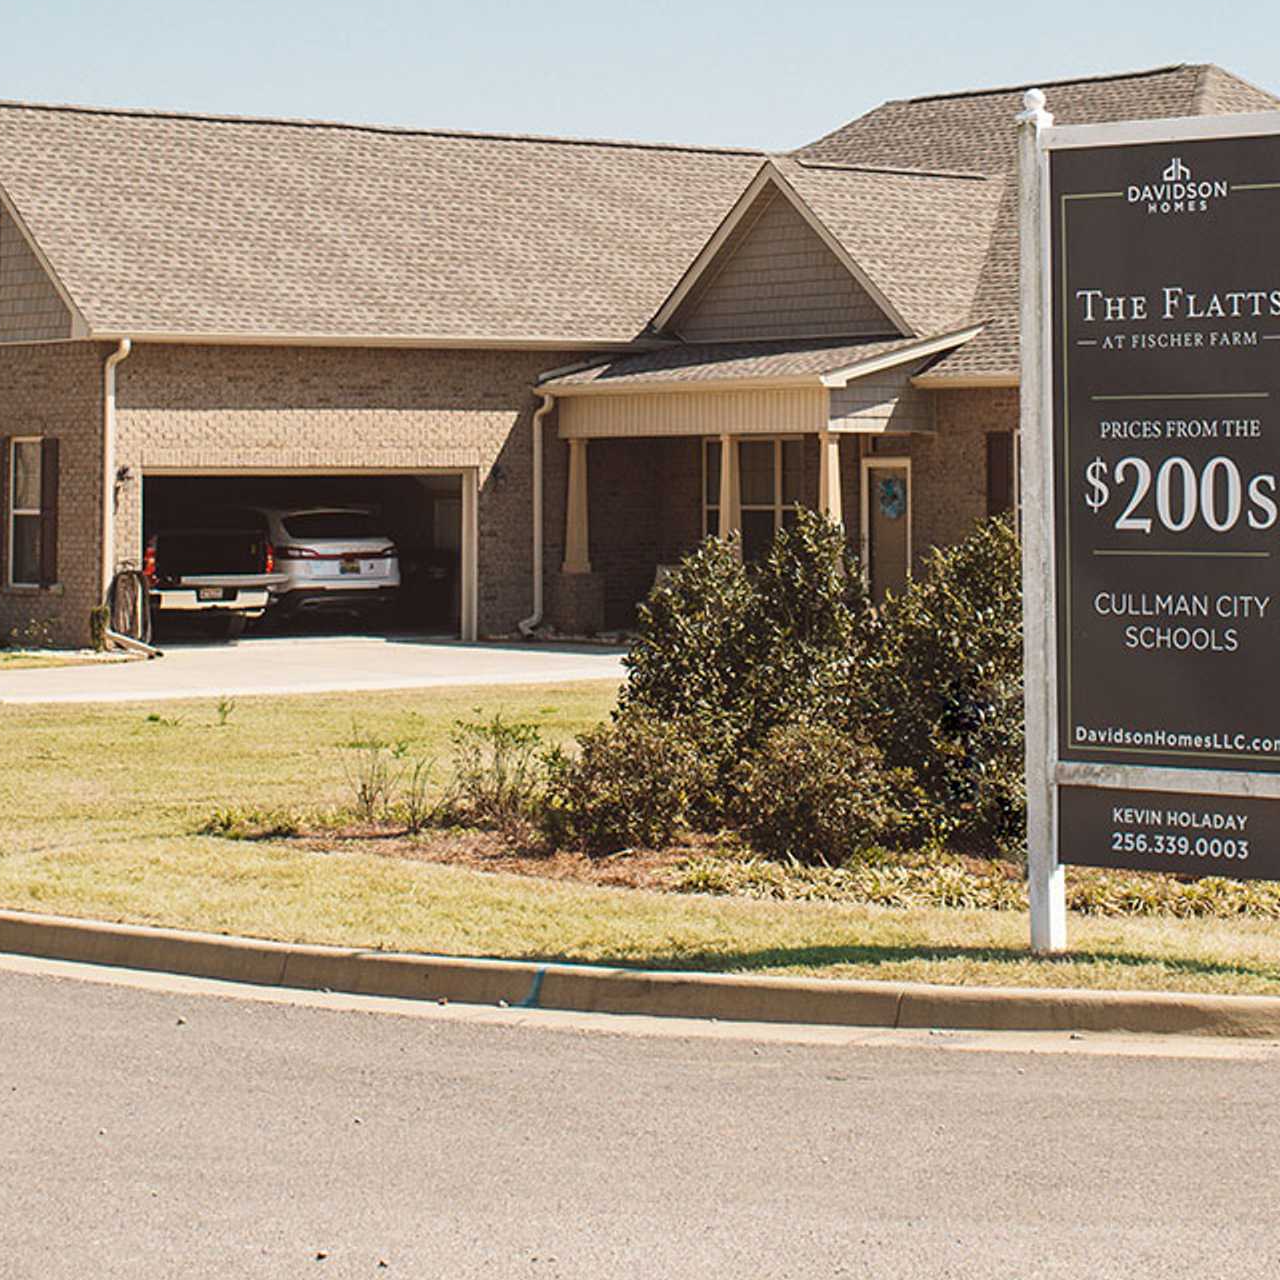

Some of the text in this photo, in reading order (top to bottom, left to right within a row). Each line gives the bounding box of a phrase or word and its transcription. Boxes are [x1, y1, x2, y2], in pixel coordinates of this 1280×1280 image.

[1128, 181, 1228, 202] DAVIDSON
[1148, 200, 1208, 214] HOMES
[1076, 289, 1147, 321] THE
[1102, 332, 1258, 349] AT FISCHER FARM
[1100, 419, 1261, 439] PRICES FROM THE
[1084, 455, 1278, 535] $200s
[1094, 592, 1270, 619] CULLMAN CITY
[1125, 627, 1238, 652] SCHOOLS
[1112, 807, 1248, 831] KEVIN HOLADAY
[1112, 832, 1248, 859] 256.339.0003
